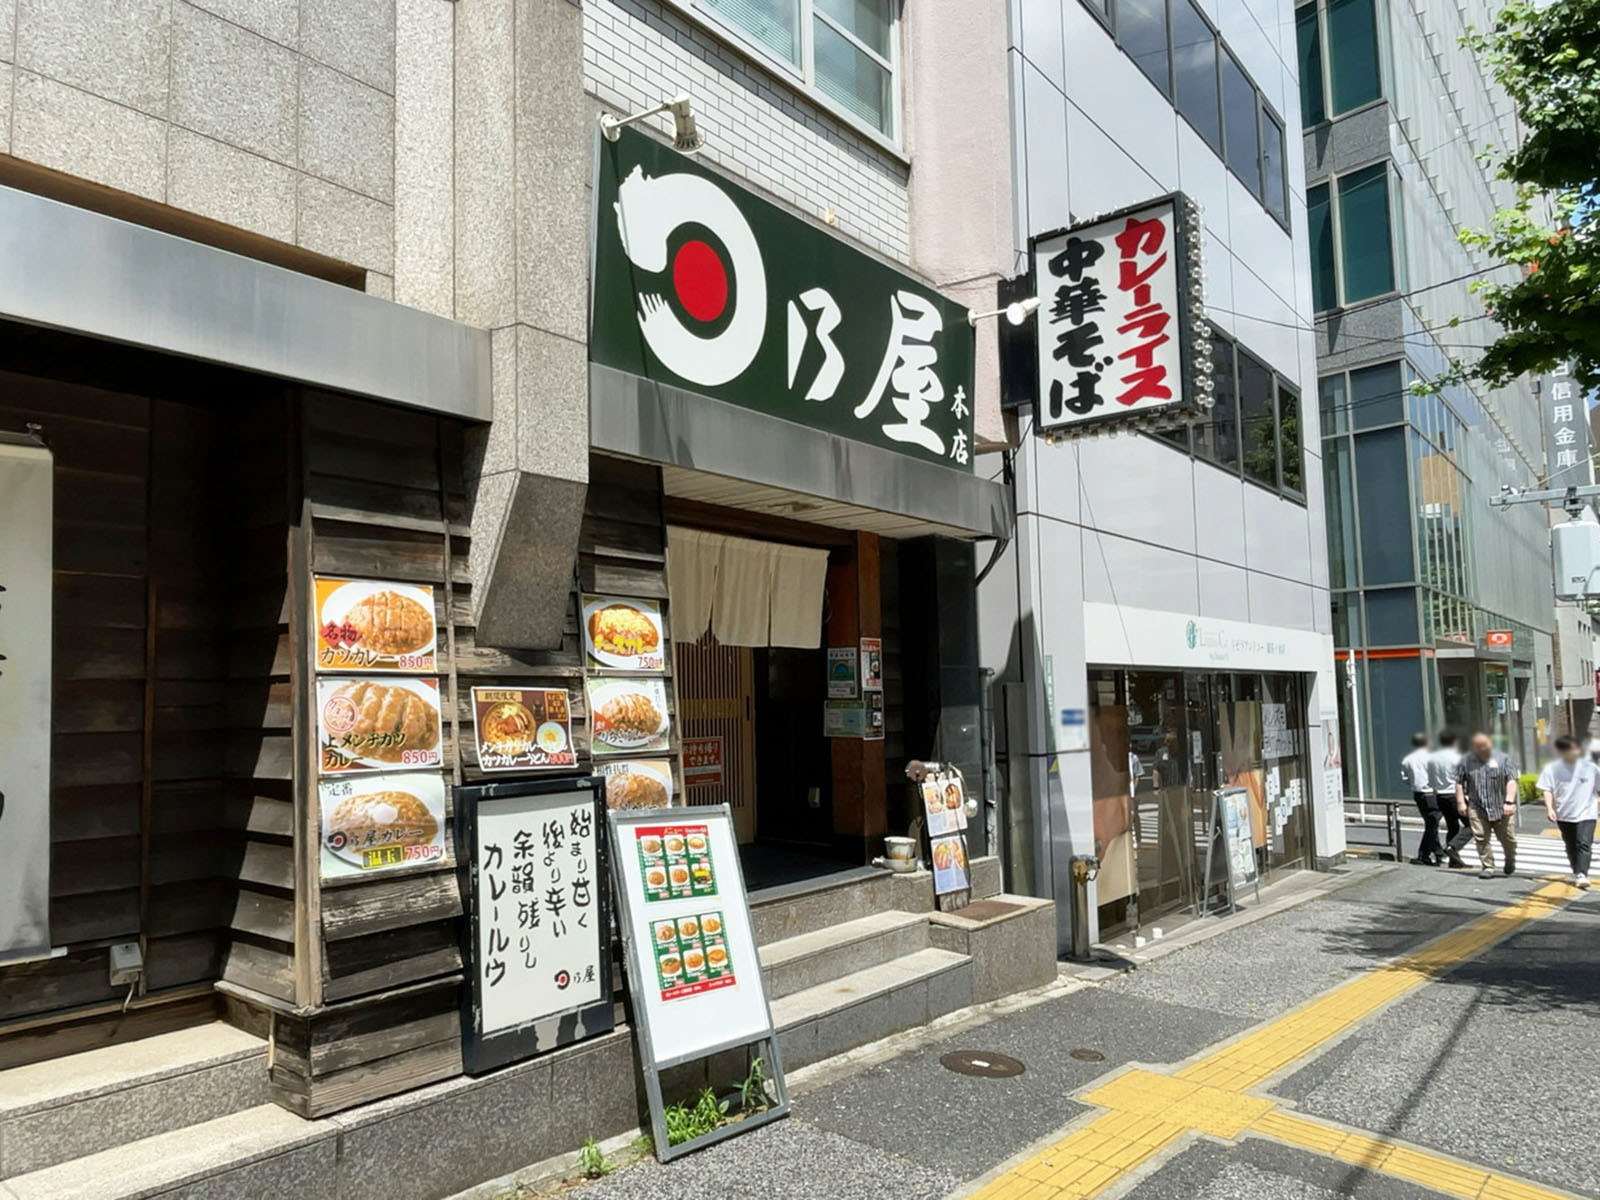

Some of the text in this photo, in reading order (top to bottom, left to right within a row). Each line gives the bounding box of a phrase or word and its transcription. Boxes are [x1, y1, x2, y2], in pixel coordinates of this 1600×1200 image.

[1048, 236, 1112, 420] 中華そば
[1115, 216, 1174, 407] カレーライス
[950, 384, 970, 466] 本店
[320, 646, 396, 666] カツカレー
[323, 624, 361, 642] 名物
[398, 655, 434, 669] 850円
[637, 656, 663, 668] 750円
[325, 752, 364, 769] カレー
[402, 751, 438, 765] 850円
[404, 845, 439, 860] 750円
[541, 819, 567, 937] 後より辛い
[570, 808, 593, 928] 始まり甘く
[482, 843, 511, 988] カレールウ
[511, 830, 541, 970] 余韻残りし
